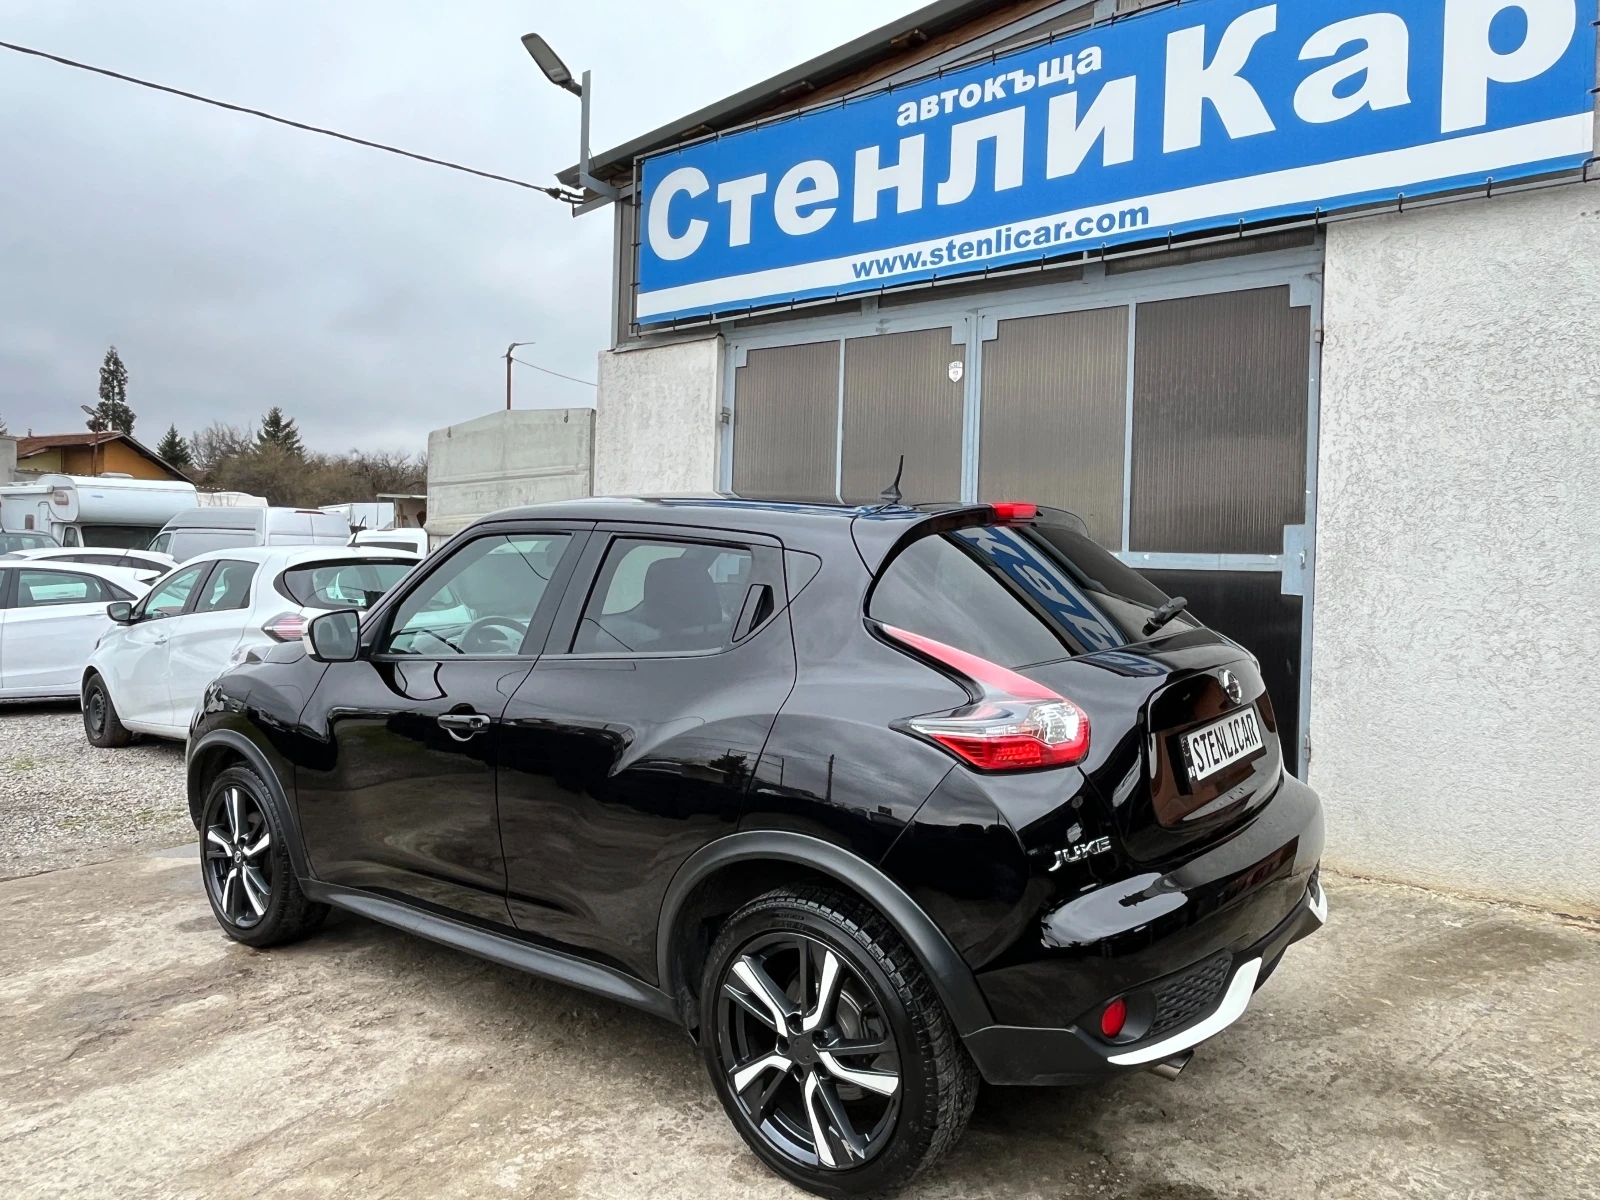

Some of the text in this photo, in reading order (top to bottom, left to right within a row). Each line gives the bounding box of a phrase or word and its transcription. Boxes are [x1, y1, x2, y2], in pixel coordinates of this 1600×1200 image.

[896, 45, 1102, 127] автокъща
[852, 206, 1149, 280] www.stenlicar.com
[1192, 713, 1259, 773] STENLICAR
[1048, 836, 1112, 872] JUKE
